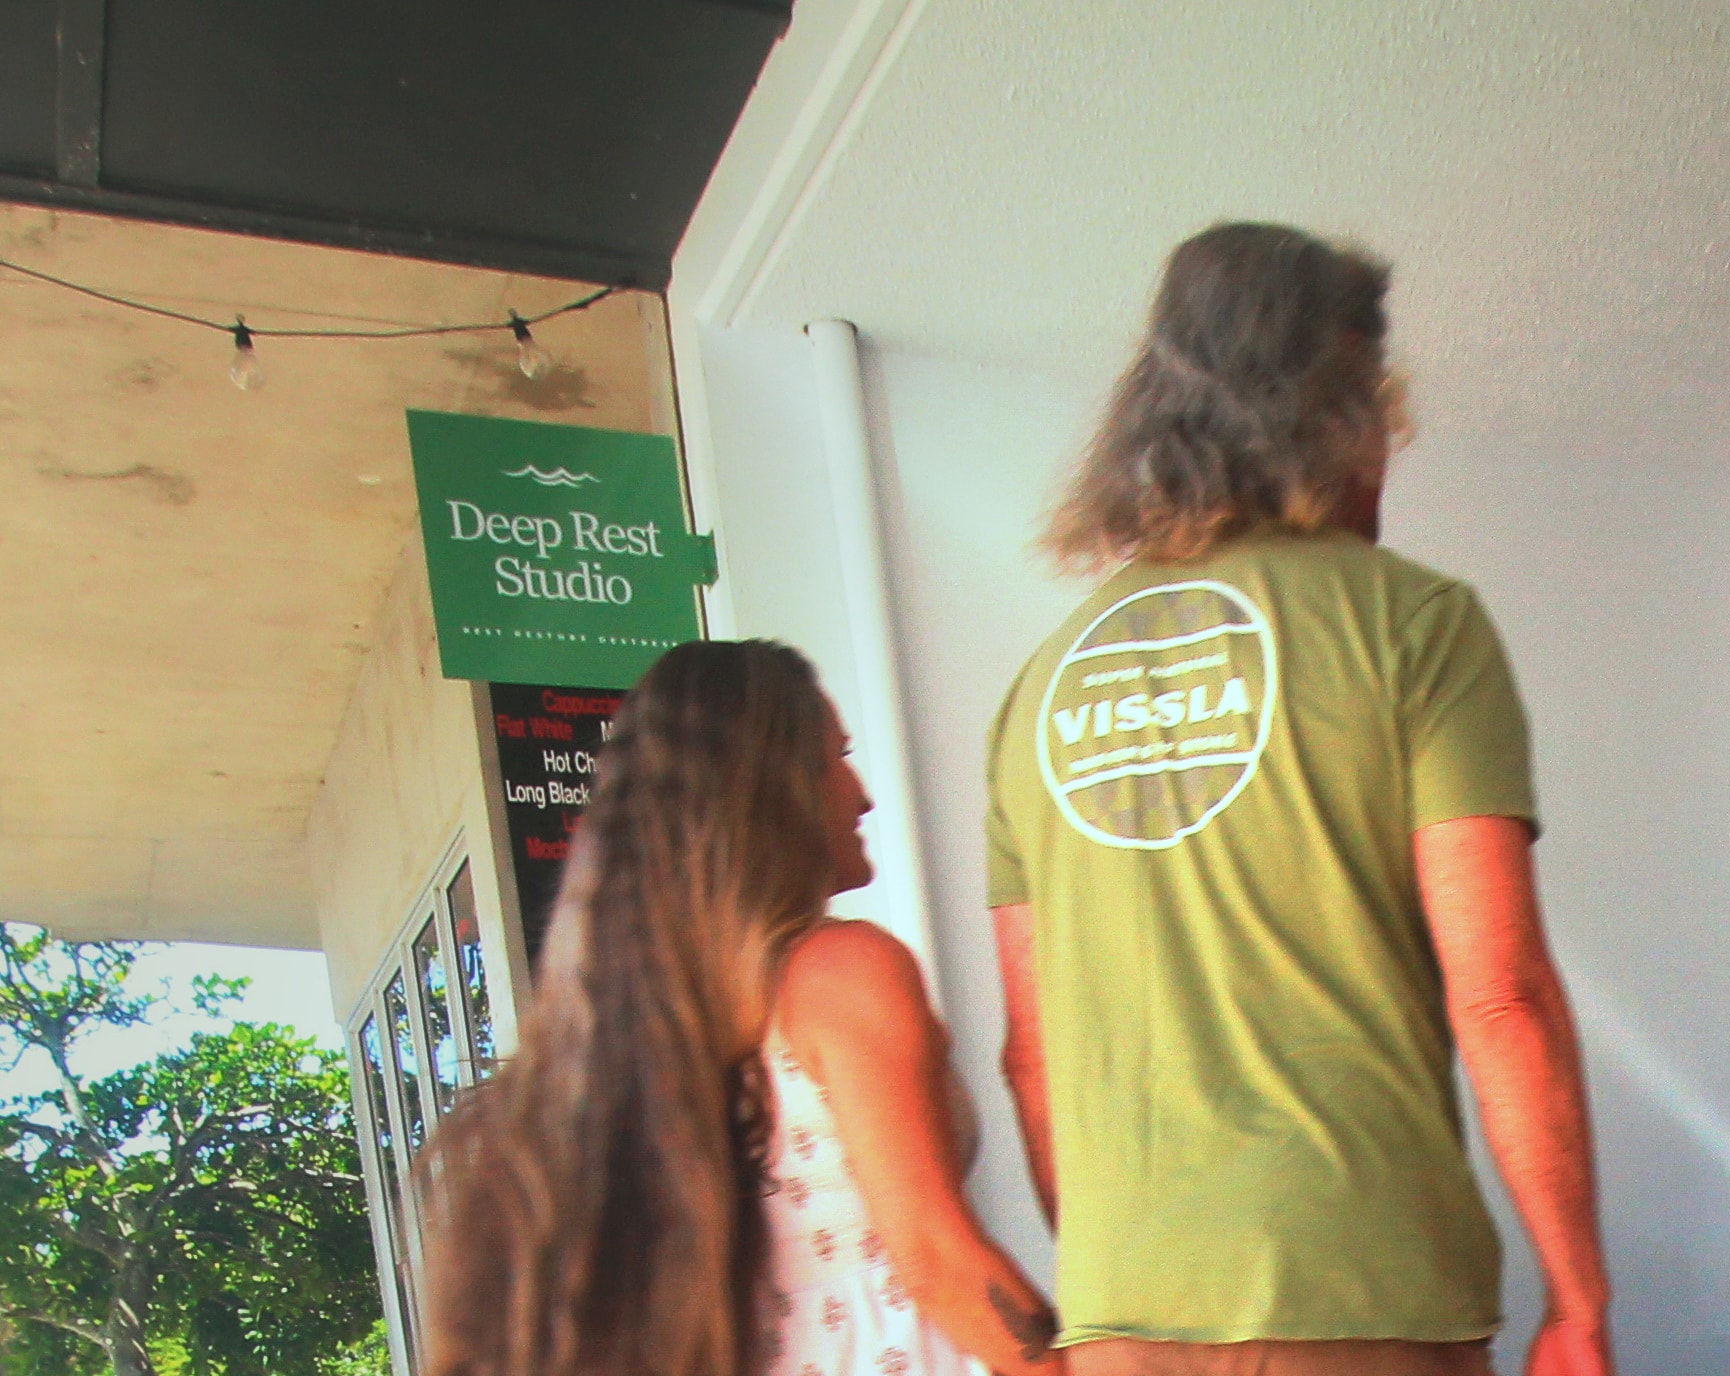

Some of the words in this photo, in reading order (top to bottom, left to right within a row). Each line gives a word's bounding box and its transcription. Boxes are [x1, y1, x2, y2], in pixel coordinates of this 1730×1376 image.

[446, 499, 562, 557] Deep
[569, 511, 664, 557] Rest
[494, 556, 633, 606] Studio
[1053, 677, 1250, 746] VISSLA
[543, 750, 572, 773] Hot
[505, 779, 546, 809] Long
[548, 781, 591, 806] Black
